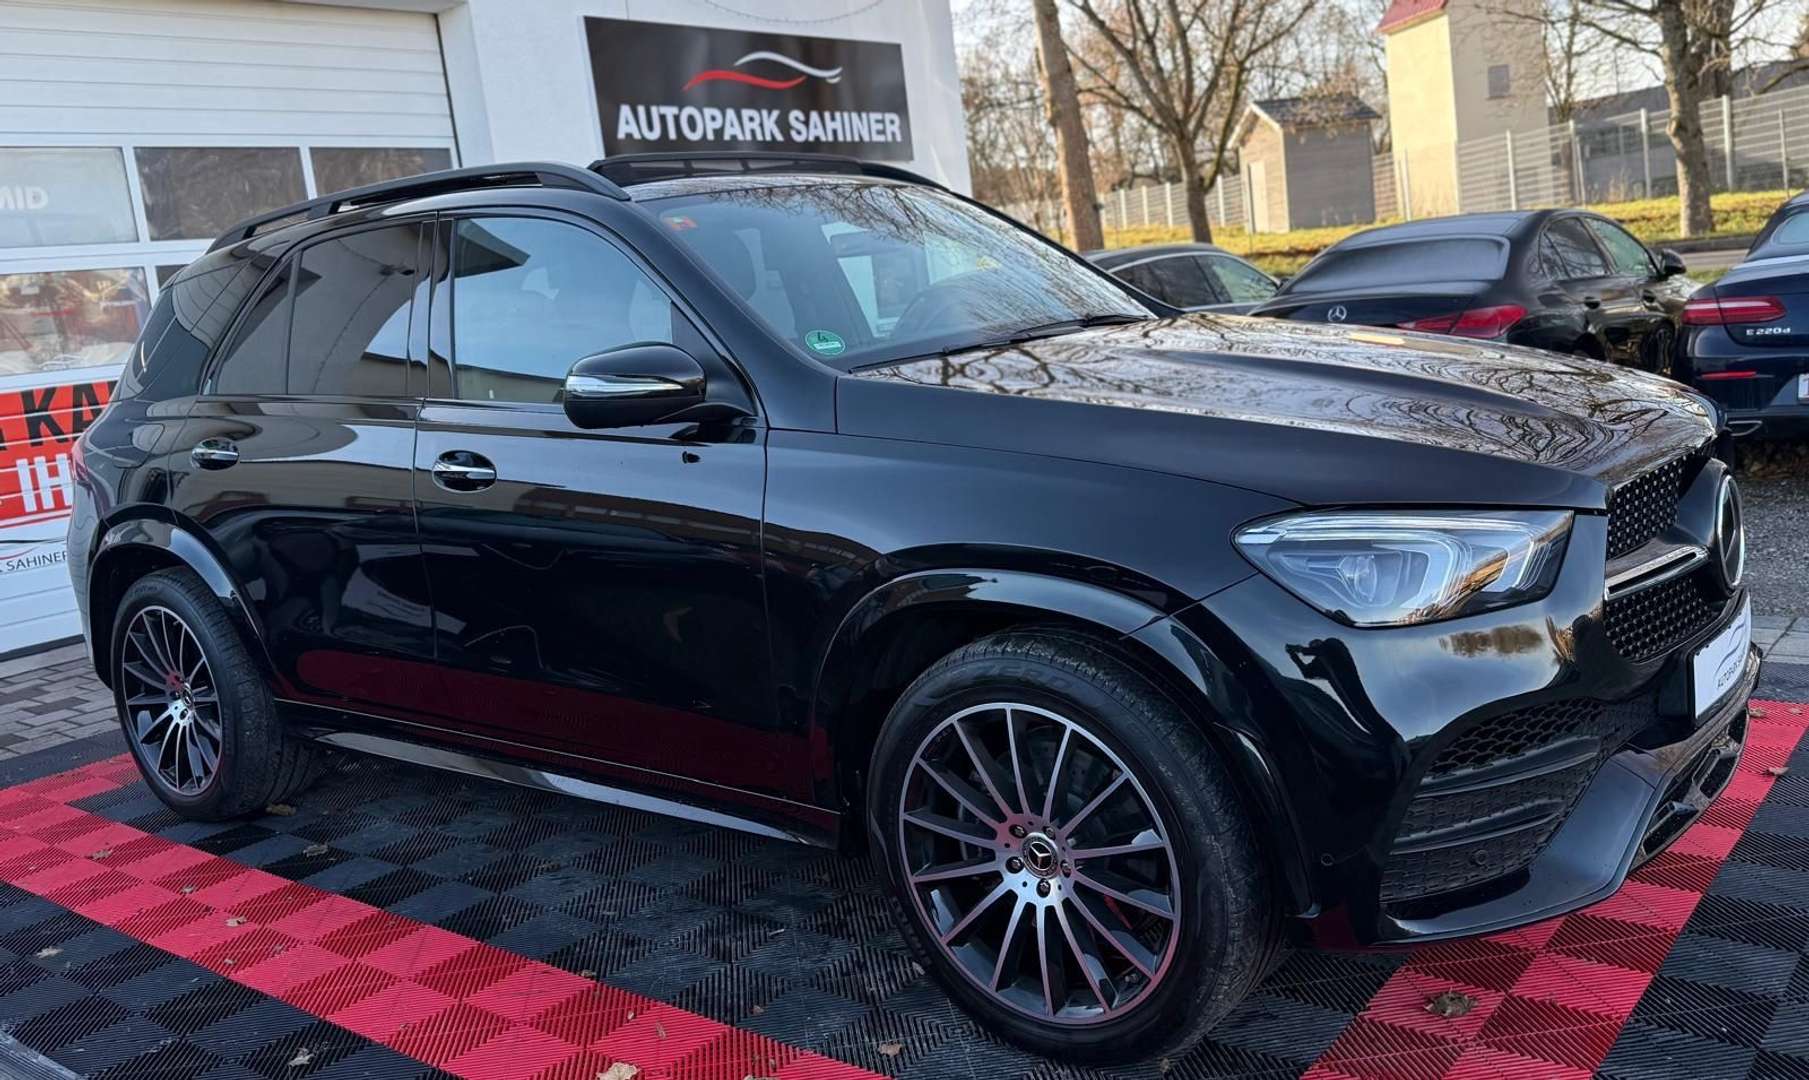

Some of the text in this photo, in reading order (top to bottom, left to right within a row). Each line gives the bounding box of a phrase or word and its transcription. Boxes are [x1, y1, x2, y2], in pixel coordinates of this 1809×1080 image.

[616, 104, 901, 143] AUTOPARK SAHINER
[21, 381, 118, 447] KA
